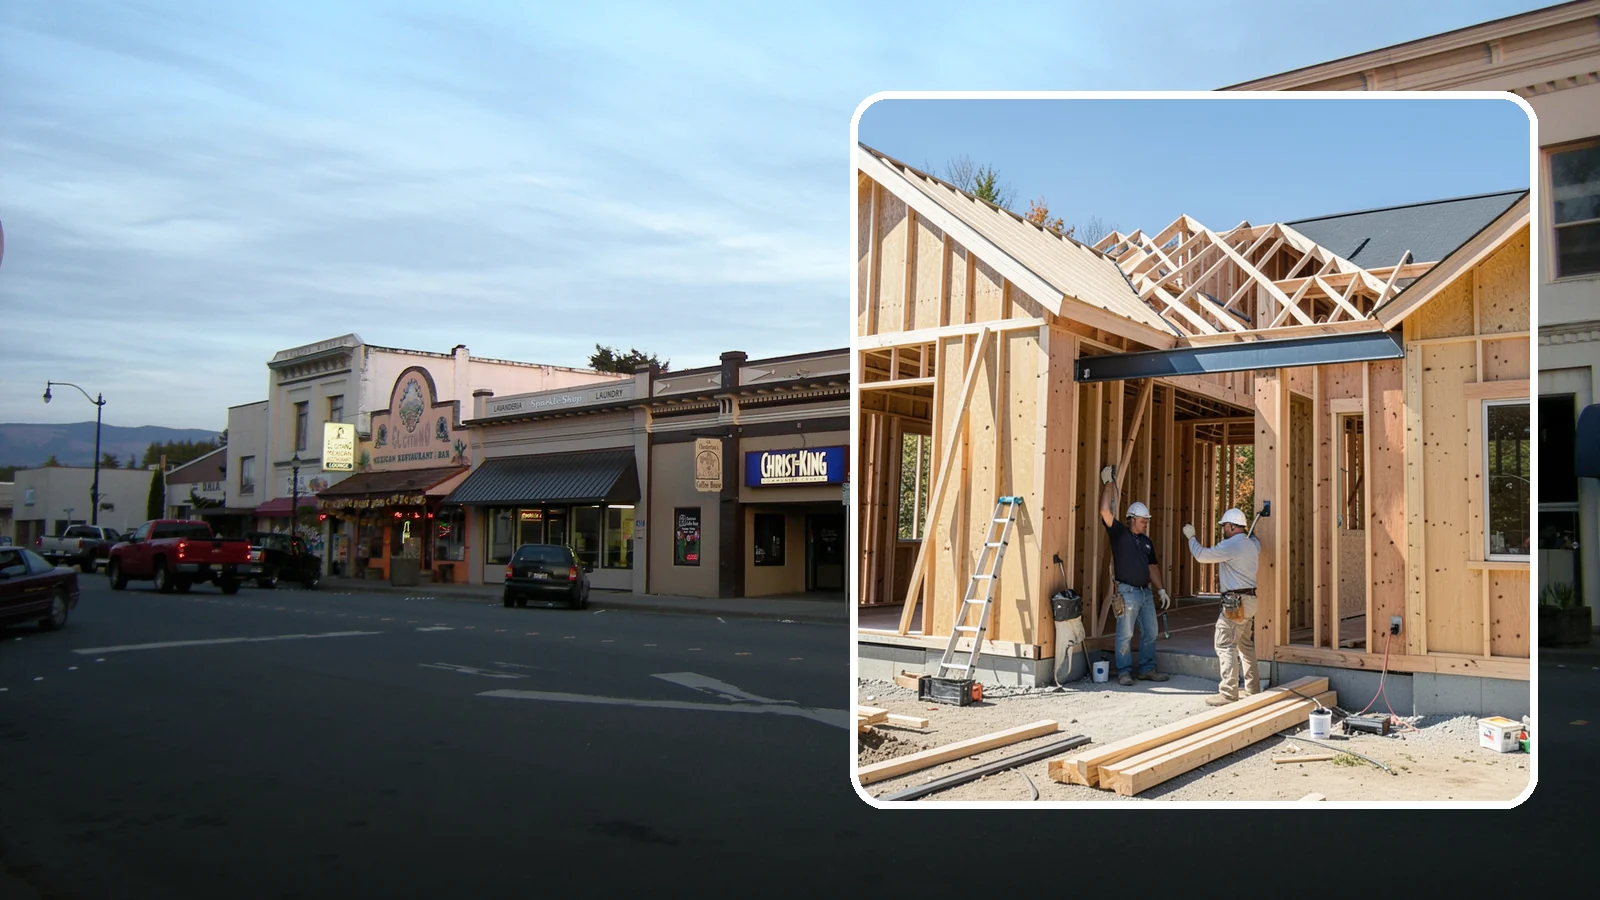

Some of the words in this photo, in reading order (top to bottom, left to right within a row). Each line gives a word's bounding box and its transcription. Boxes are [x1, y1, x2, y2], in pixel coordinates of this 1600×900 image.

[595, 389, 624, 400] LAUNDRY
[493, 402, 523, 413] LAVANDERIA
[530, 396, 561, 409] Sparkle
[562, 395, 582, 407] Shop
[373, 454, 396, 464] MEXICAN
[397, 451, 433, 462] RESTAURANT
[437, 450, 450, 459] BAR
[760, 452, 797, 478] CHRIST
[799, 450, 828, 476] KING
